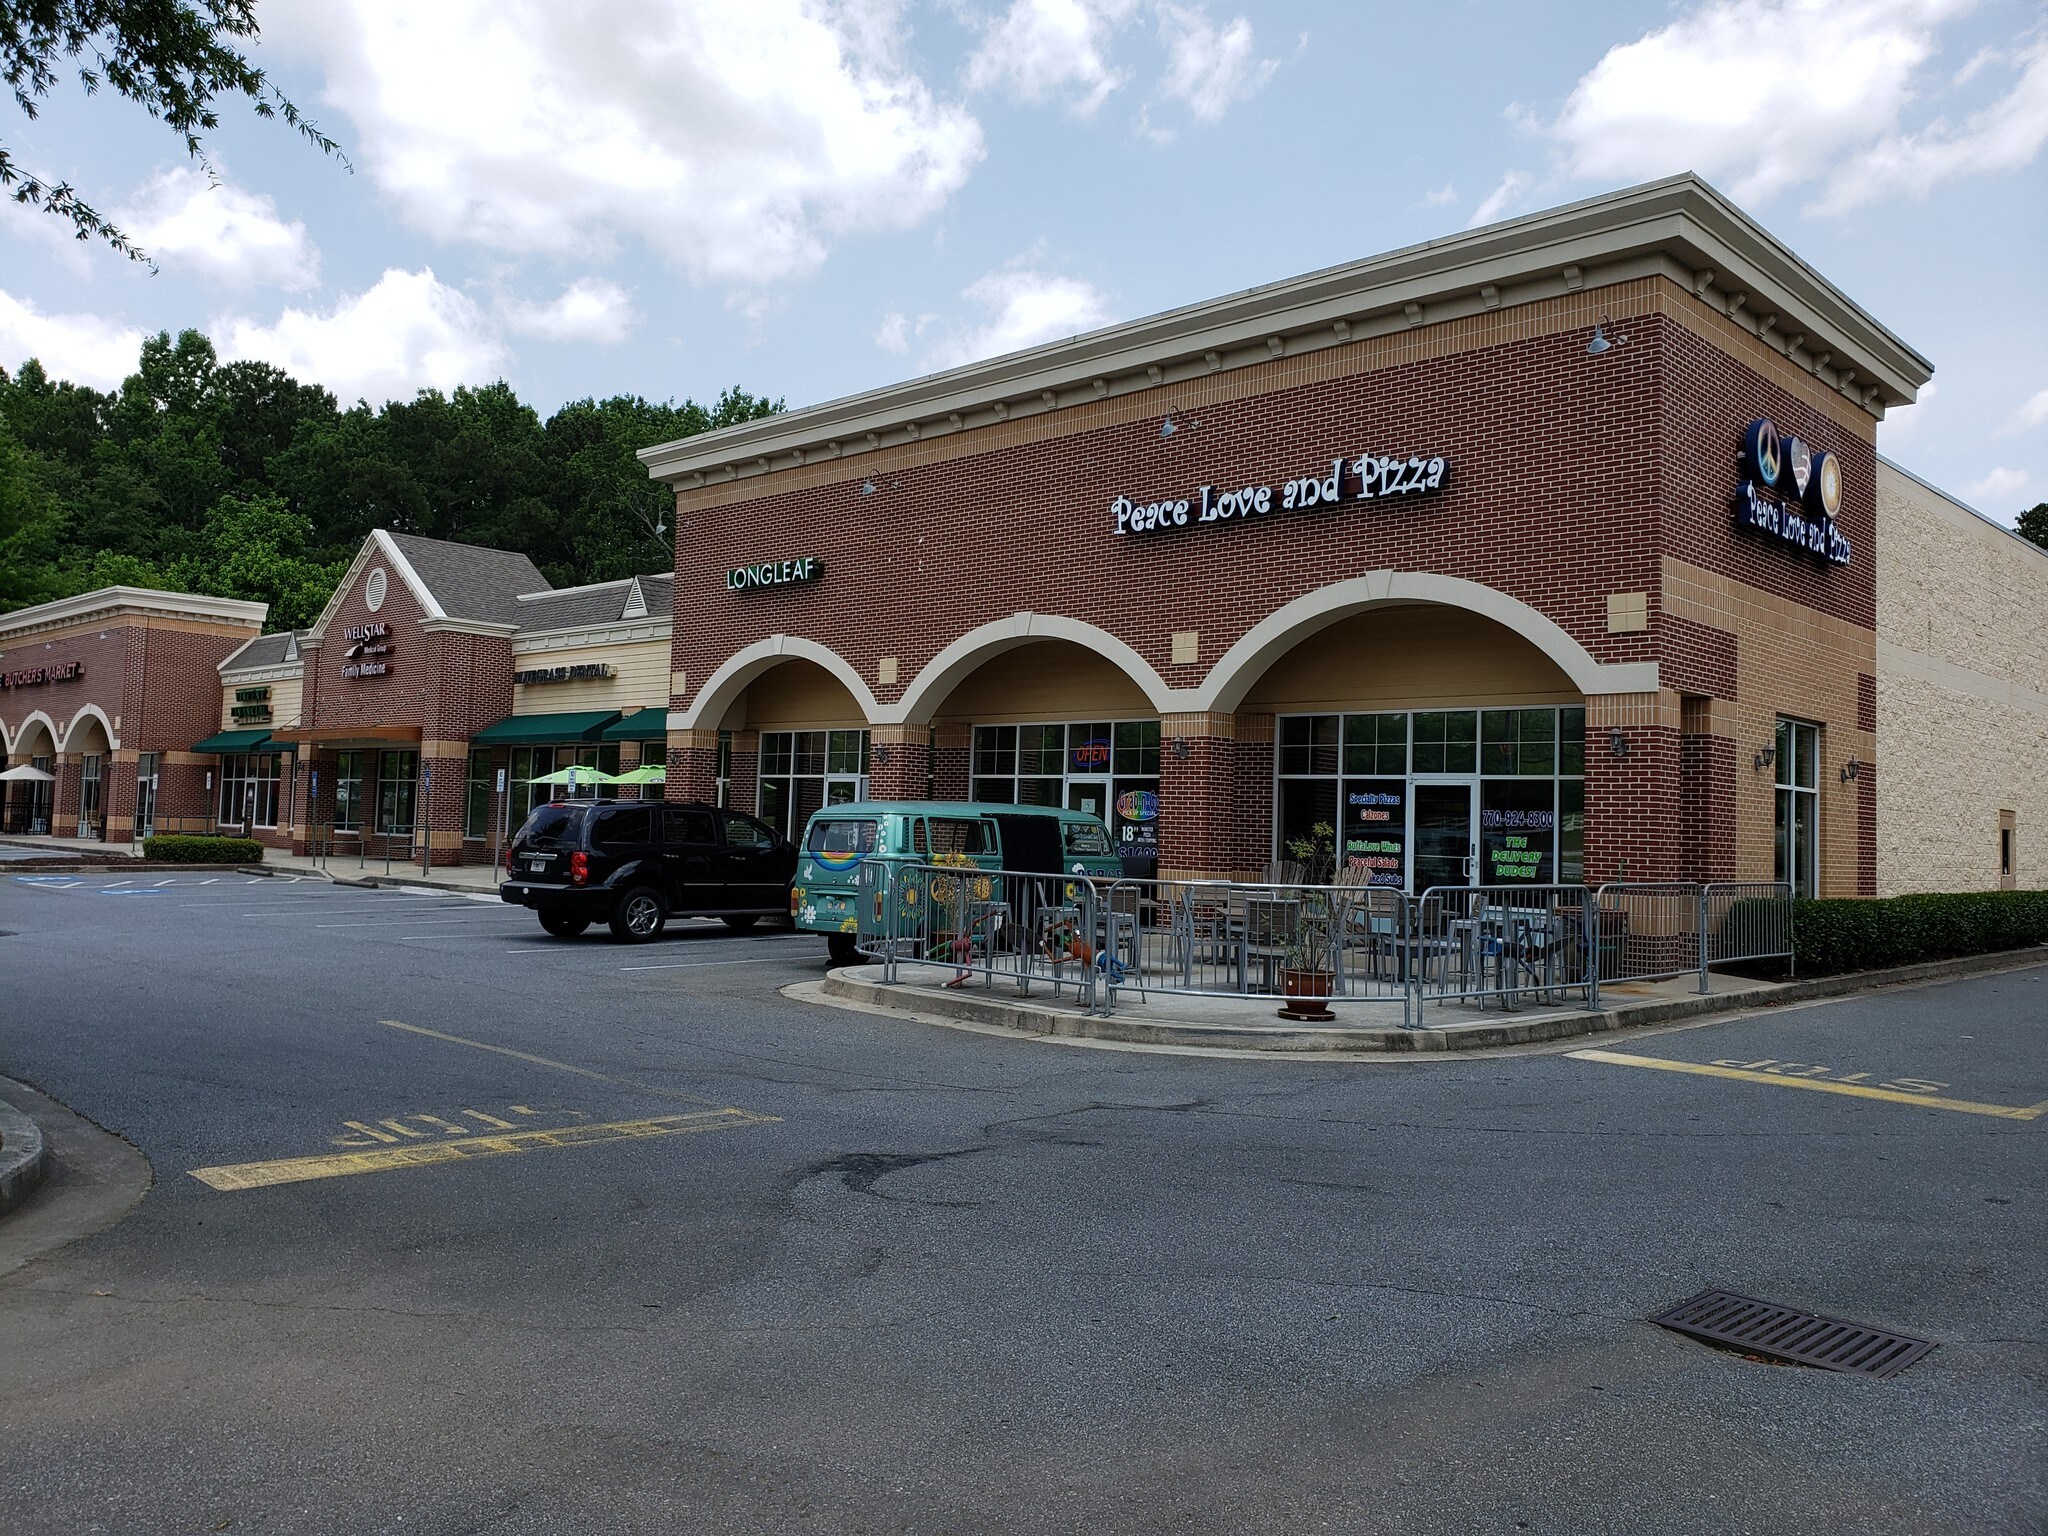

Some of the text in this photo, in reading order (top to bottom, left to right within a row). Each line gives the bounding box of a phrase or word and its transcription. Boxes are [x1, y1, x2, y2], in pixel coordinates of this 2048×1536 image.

[1111, 452, 1446, 535] Peace Love and Pizza
[1747, 480, 1851, 565] Peace Love and Pizza
[726, 558, 815, 590] LONGLEAF
[344, 622, 386, 642] WELLSTAR
[44, 661, 77, 682] MARKET
[341, 661, 386, 679] Family Medicine
[1076, 744, 1108, 762] OPEN
[1379, 793, 1400, 805] Pizzas
[1361, 808, 1390, 820] Calzones
[1482, 809, 1554, 828] 770-924-8300
[1380, 841, 1401, 853] Wings
[1505, 836, 1528, 848] THE
[1349, 856, 1399, 869] Peaceful Salads
[1491, 850, 1542, 863] DELIVERY
[1386, 873, 1403, 885] Subs
[1496, 864, 1537, 879] DUDES!
